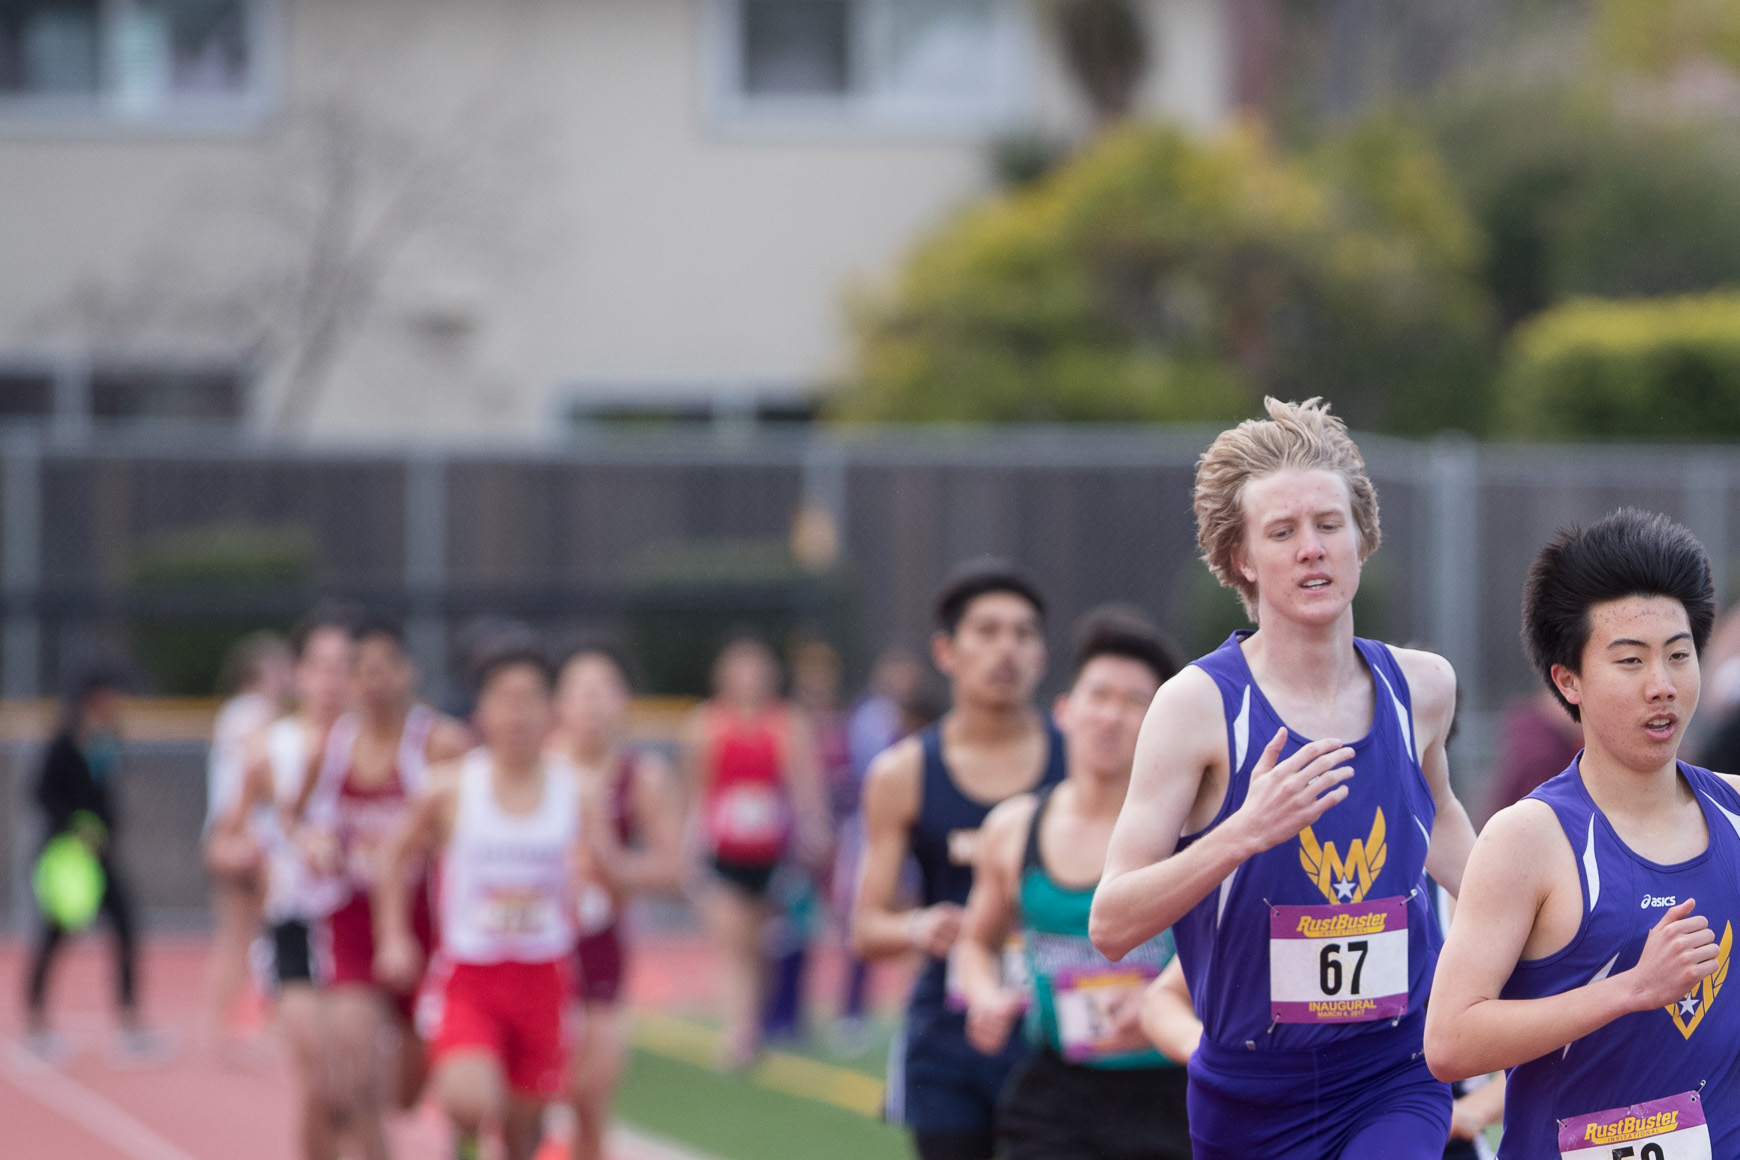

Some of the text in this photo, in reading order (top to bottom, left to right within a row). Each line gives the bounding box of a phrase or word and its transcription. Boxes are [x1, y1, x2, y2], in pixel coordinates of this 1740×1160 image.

[1650, 895, 1677, 908] asics
[1296, 912, 1387, 933] RustBuster
[1319, 940, 1369, 996] 67
[1308, 999, 1377, 1012] INAUGURAL
[1584, 1110, 1679, 1141] RustBuster
[1607, 1129, 1660, 1142] INVITATIONAL
